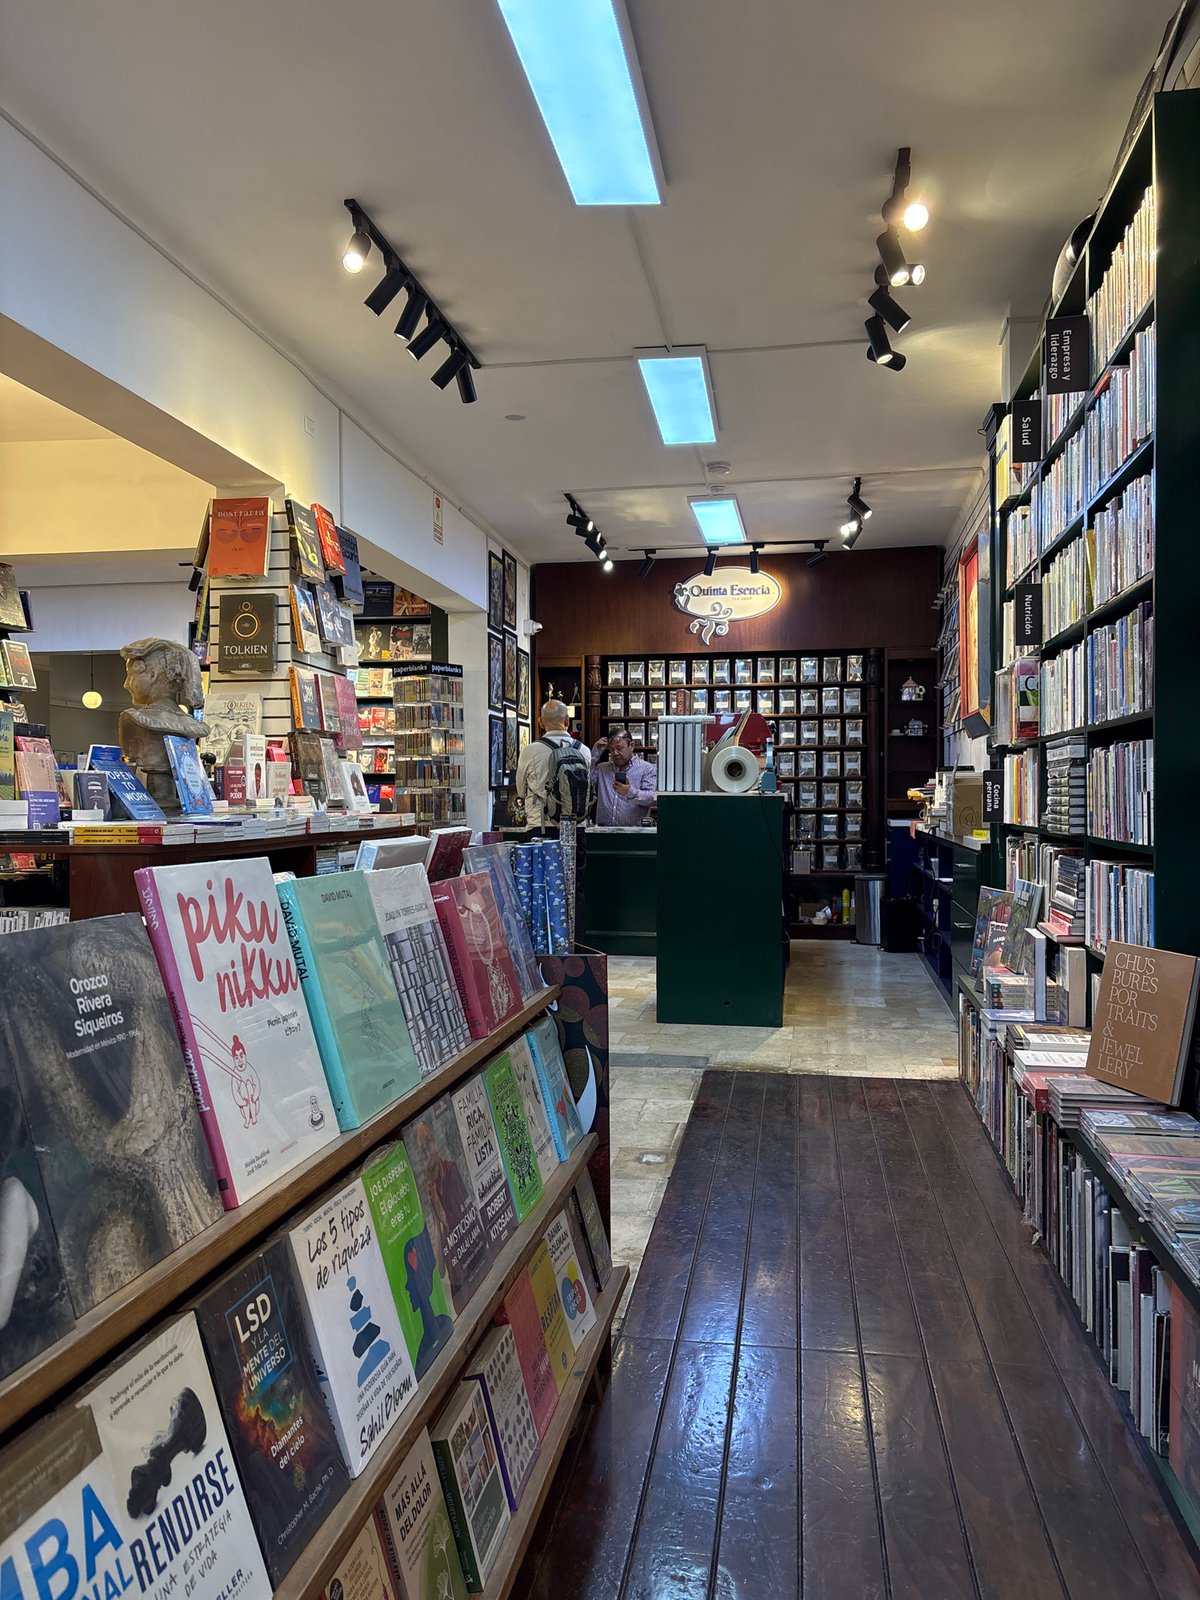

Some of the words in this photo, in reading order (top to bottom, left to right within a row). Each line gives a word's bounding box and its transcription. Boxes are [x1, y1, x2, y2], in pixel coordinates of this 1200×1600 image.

[1048, 333, 1060, 380] liderazgo
[1061, 329, 1072, 373] Empresa
[1021, 416, 1032, 446] Salud
[690, 584, 727, 597] Quinta
[730, 584, 770, 596] Esencia
[1024, 594, 1033, 635] Nutrición
[223, 644, 268, 655] TOLKIEN
[394, 664, 428, 675] paperblanks
[431, 664, 462, 674] paperblanks
[223, 700, 255, 710] TOLKIEN
[108, 770, 135, 781] OPEN
[121, 781, 135, 791] TO
[123, 791, 152, 801] WORK
[985, 781, 993, 812] peruana
[993, 784, 1001, 809] Cocina
[320, 892, 337, 903] DAVID
[336, 889, 353, 900] MUTAL
[177, 877, 278, 982] piku
[280, 901, 298, 940] DAVID
[290, 939, 309, 984] MUTAL
[216, 943, 299, 1013] nikku
[1115, 952, 1156, 974] CHUS
[69, 974, 108, 995] Orozco
[1108, 986, 1138, 1008] POR
[76, 993, 112, 1015] Rivera
[281, 1010, 298, 1025] japonés
[1107, 1003, 1158, 1031] TRAITS
[74, 1011, 124, 1037] Siqueiros
[1102, 1020, 1115, 1037] &
[66, 1044, 95, 1060] Modernidad
[94, 1042, 101, 1050] en
[1096, 1053, 1134, 1079] LERY
[1099, 1037, 1144, 1065] JEWEL
[457, 1085, 483, 1116] FAMILIA
[466, 1106, 486, 1131] RICA,
[466, 1119, 492, 1152] FAMILIA
[474, 1139, 494, 1167] LISTA
[369, 1183, 382, 1202] JOE
[382, 1160, 408, 1187] DISPENZA
[379, 1199, 388, 1216] El
[387, 1183, 410, 1211] placebo
[486, 1188, 507, 1219] ROBERT
[307, 1232, 328, 1263] Los
[328, 1217, 338, 1245] 5
[340, 1200, 365, 1238] tipos
[390, 1210, 404, 1228] eres
[446, 1207, 476, 1250] MISTICISMO
[469, 1225, 481, 1244] LAMA
[489, 1205, 514, 1241] KIYOSAKI
[547, 1221, 563, 1241] DANIEL
[316, 1264, 329, 1290] de
[332, 1225, 371, 1275] riqueza
[234, 1292, 272, 1344] LSD
[250, 1339, 257, 1349] Y
[258, 1328, 270, 1344] LA
[243, 1345, 269, 1377] MENTE
[268, 1332, 285, 1352] DEL
[248, 1346, 286, 1391] UNIVERSO
[110, 1386, 130, 1404] Destruye
[129, 1380, 134, 1388] el
[134, 1372, 143, 1384] mito
[143, 1368, 149, 1376] de
[148, 1364, 154, 1372] la
[153, 1344, 178, 1369] meritocracia
[112, 1397, 131, 1417] aprende
[134, 1379, 153, 1399] renunciar
[156, 1370, 161, 1378] lo
[161, 1364, 169, 1375] que
[168, 1360, 173, 1368] te
[357, 1392, 365, 1404] UNA
[364, 1371, 381, 1395] PODEROSA
[388, 1352, 397, 1367] PARA
[356, 1402, 370, 1421] DISEÑAR
[373, 1386, 382, 1400] VIDA
[381, 1379, 386, 1390] DE
[360, 1402, 385, 1457] Sahil
[384, 1375, 413, 1421] Bloom
[270, 1417, 304, 1458] Diamantes
[279, 1456, 290, 1470] del
[290, 1434, 305, 1456] cielo
[393, 1493, 411, 1522] MÁS
[410, 1459, 428, 1493] ALLÁ
[129, 1448, 236, 1594] RENDIRSE
[277, 1508, 304, 1545] Christopher
[400, 1521, 413, 1542] DEL
[412, 1482, 432, 1523] DOLOR
[0, 1483, 124, 1600] BA
[183, 1508, 233, 1575] ESTRATEGIA
[154, 1573, 178, 1600] UNA
[185, 1576, 197, 1598] DE
[199, 1550, 219, 1579] VIDA
